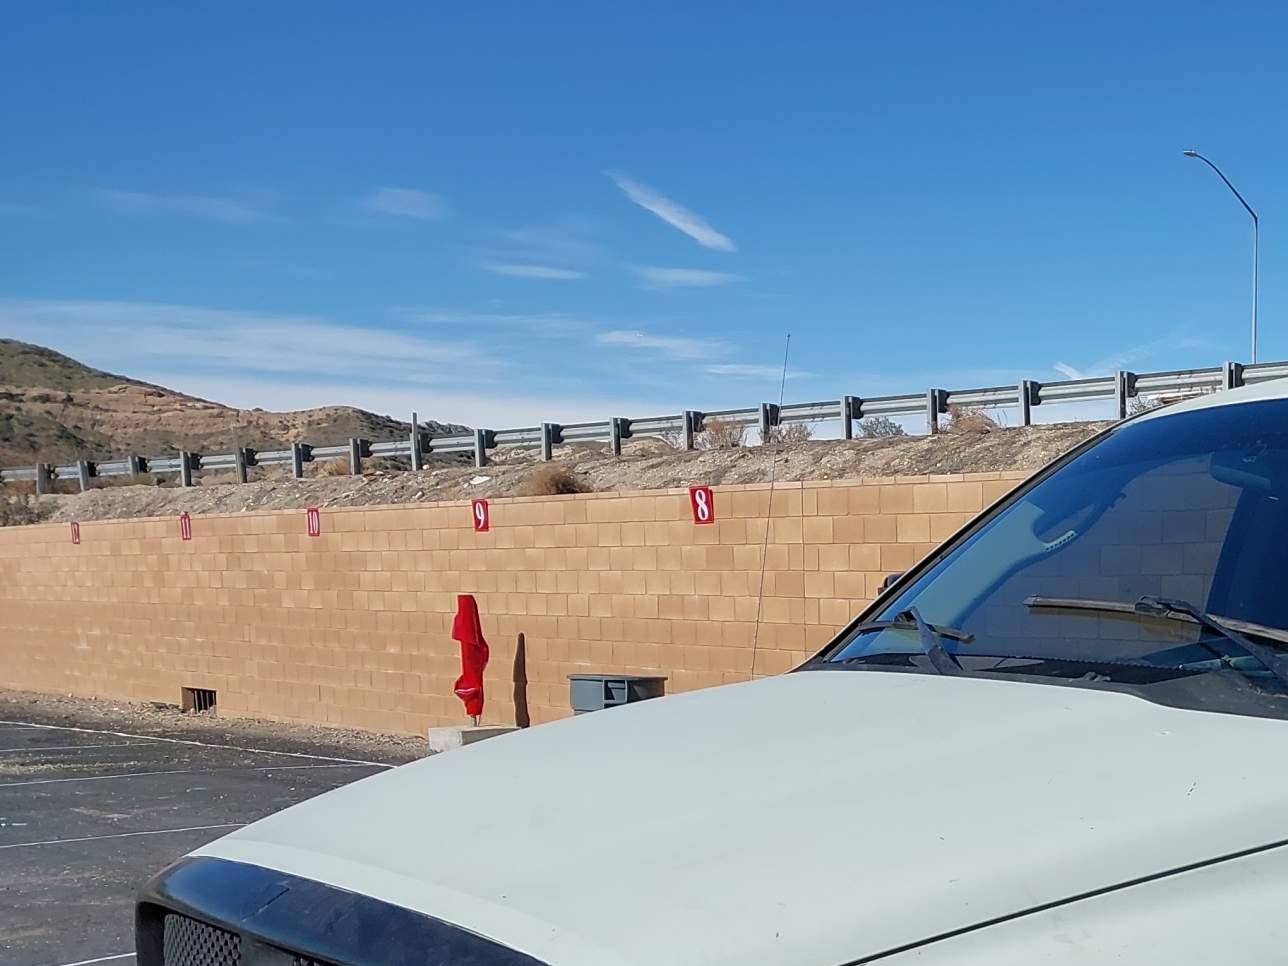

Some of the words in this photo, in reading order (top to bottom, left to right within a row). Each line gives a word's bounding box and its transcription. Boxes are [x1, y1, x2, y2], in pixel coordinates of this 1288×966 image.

[475, 502, 485, 529] 9
[695, 489, 709, 521] 8
[181, 517, 191, 538] 11
[308, 511, 319, 534] 10
